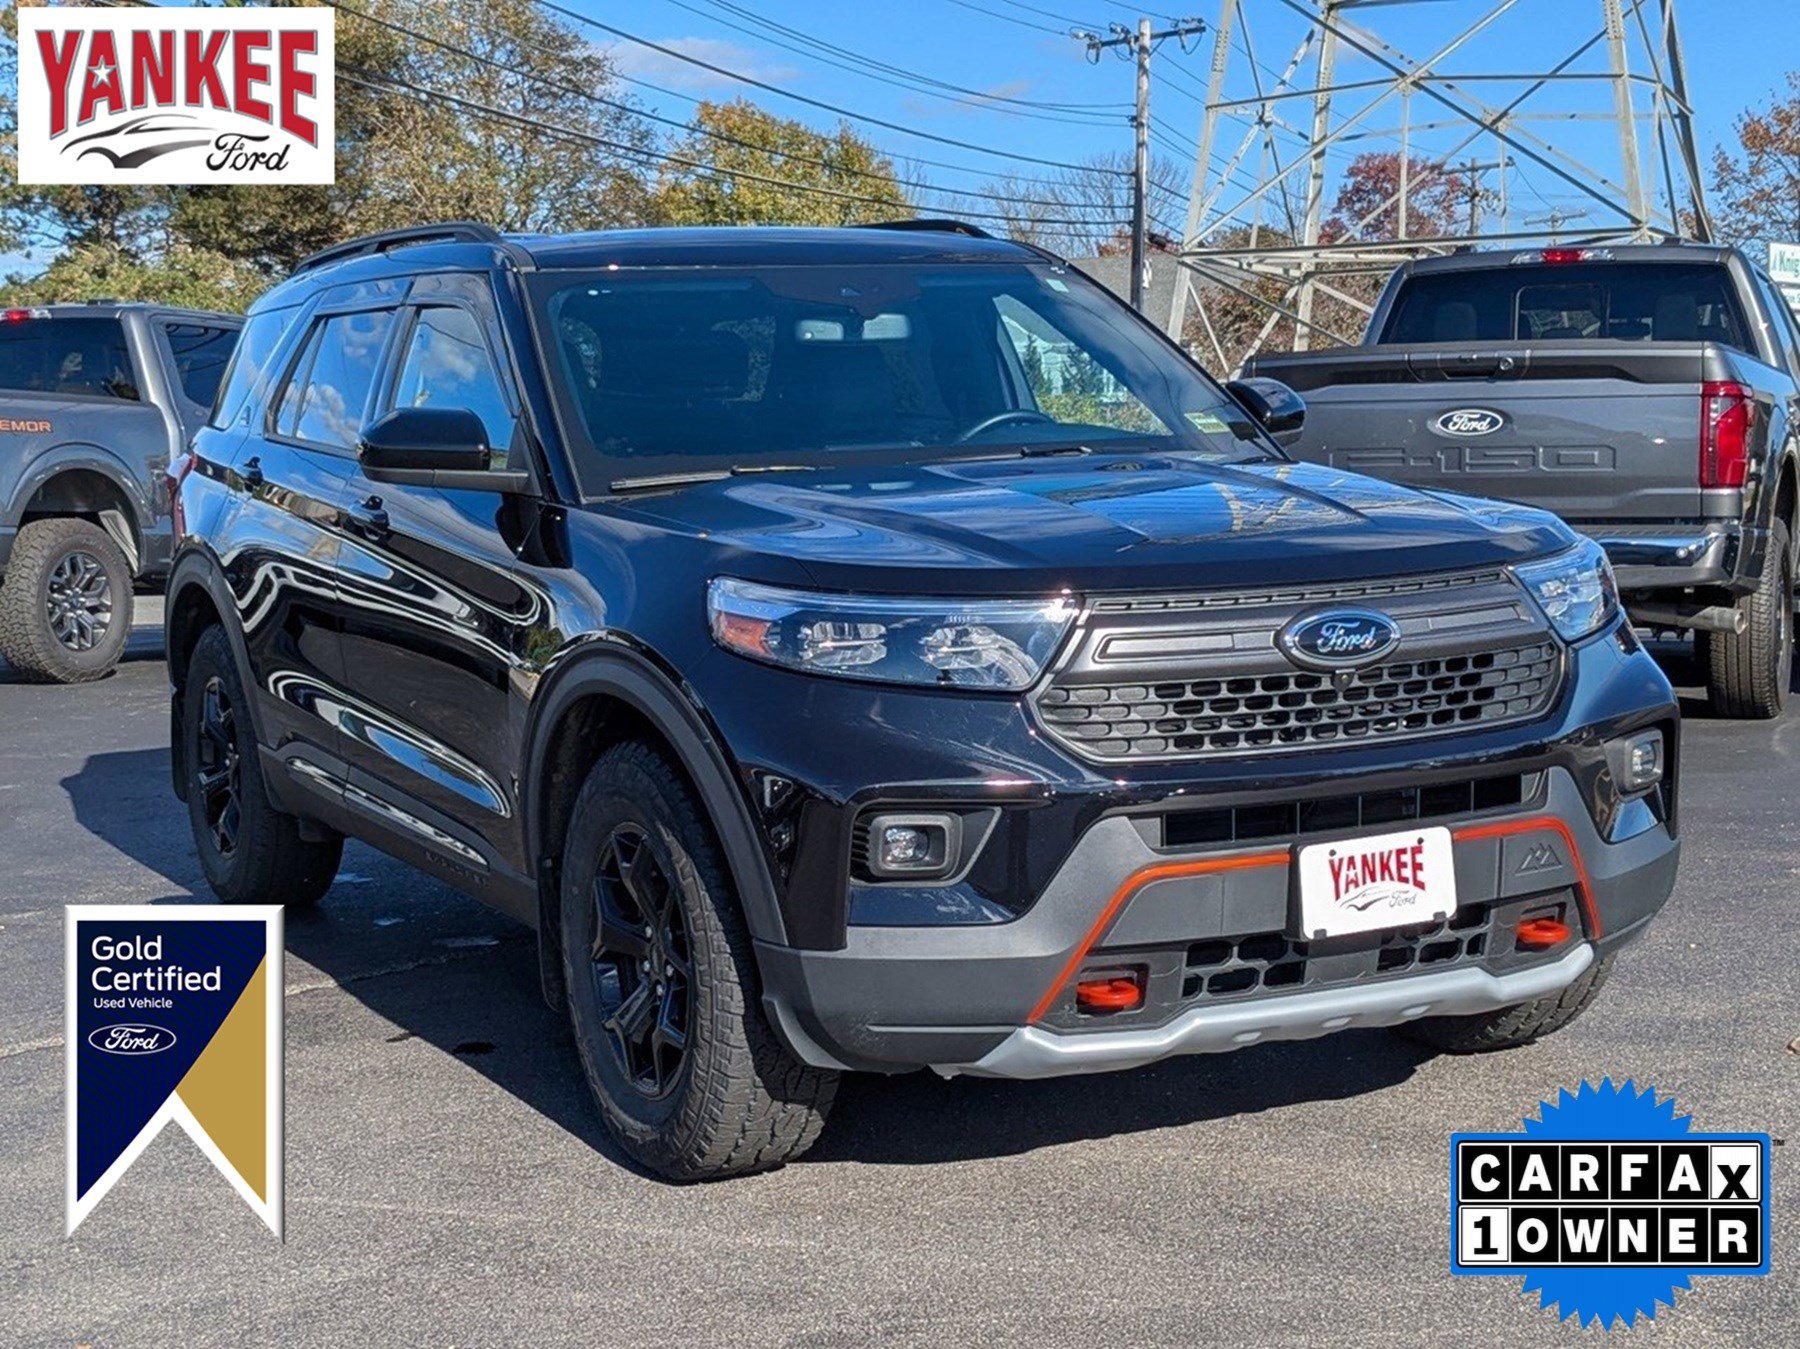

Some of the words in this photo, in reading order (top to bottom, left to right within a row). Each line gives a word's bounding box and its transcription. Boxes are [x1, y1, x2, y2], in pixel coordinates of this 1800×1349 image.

[1448, 413, 1490, 432] Ford
[1329, 443, 1616, 473] F-150
[1316, 621, 1377, 653] Ford
[1328, 845, 1426, 901] YANKEE
[1389, 890, 1417, 908] Ford
